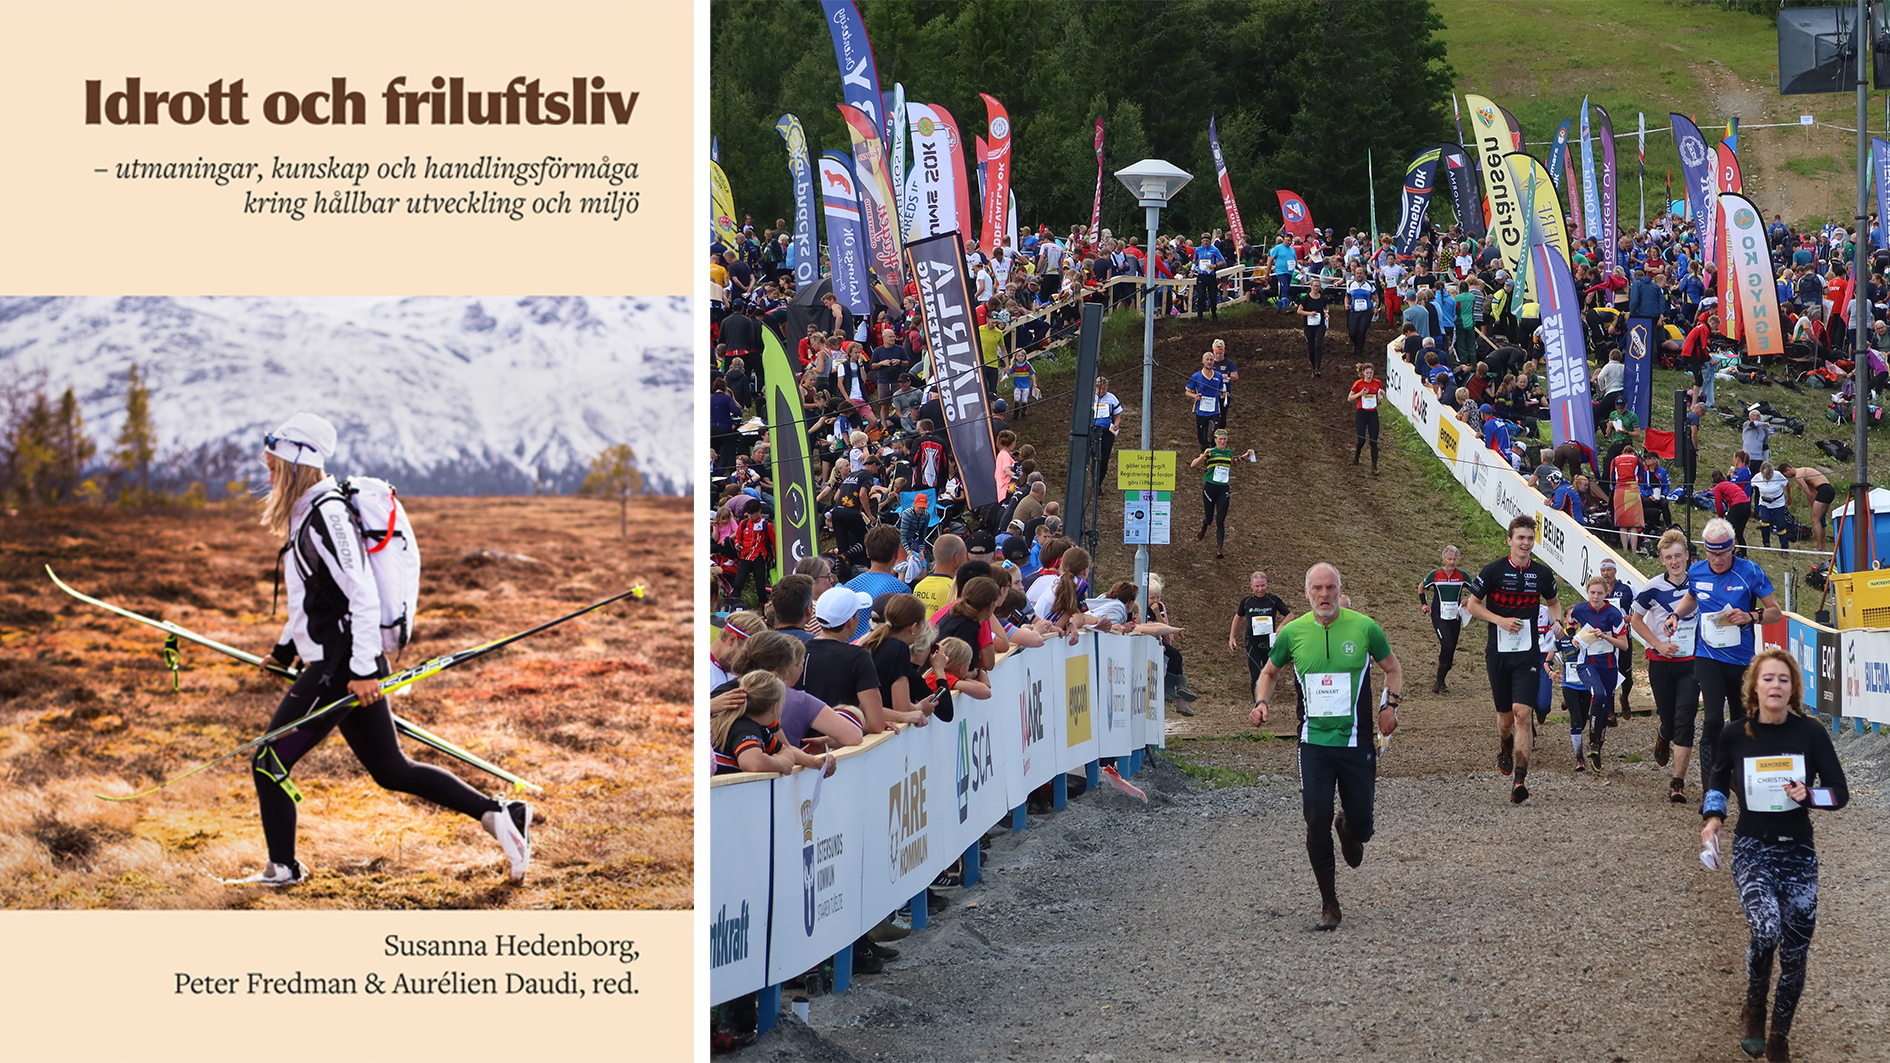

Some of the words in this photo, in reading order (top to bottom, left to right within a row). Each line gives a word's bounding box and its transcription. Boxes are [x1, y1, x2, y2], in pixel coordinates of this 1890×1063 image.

[85, 76, 250, 126] Idrott
[262, 76, 366, 126] och
[381, 75, 640, 126] friluftsliv
[116, 156, 263, 187] utmaningar,
[271, 155, 370, 187] kunskap
[377, 155, 417, 179] och
[424, 155, 639, 187] handlingsförmåga
[1414, 168, 1427, 189] OK
[243, 190, 308, 221] kring
[313, 190, 401, 214] hållbar
[406, 190, 527, 221] utveckling
[532, 190, 572, 214] och
[579, 190, 640, 222] miljö
[1584, 169, 1597, 217] ORION
[1589, 220, 1598, 241] OK
[329, 514, 354, 570] DOBSOM
[378, 656, 455, 690] ISCHER
[972, 719, 995, 793] SCA
[1757, 776, 1793, 784] CHRISTINA
[901, 756, 928, 843] ÅRE
[817, 832, 843, 865] ÖSTERSUNDS
[900, 832, 928, 878] KOMMUN
[384, 934, 488, 957] Susanna
[495, 933, 640, 964] Hedenborg,
[174, 972, 240, 995] Peter
[247, 970, 358, 995] Fredman
[364, 972, 386, 995] &
[391, 970, 498, 995] Aurélien
[505, 970, 586, 999] Daudi,
[592, 970, 639, 995] red.
